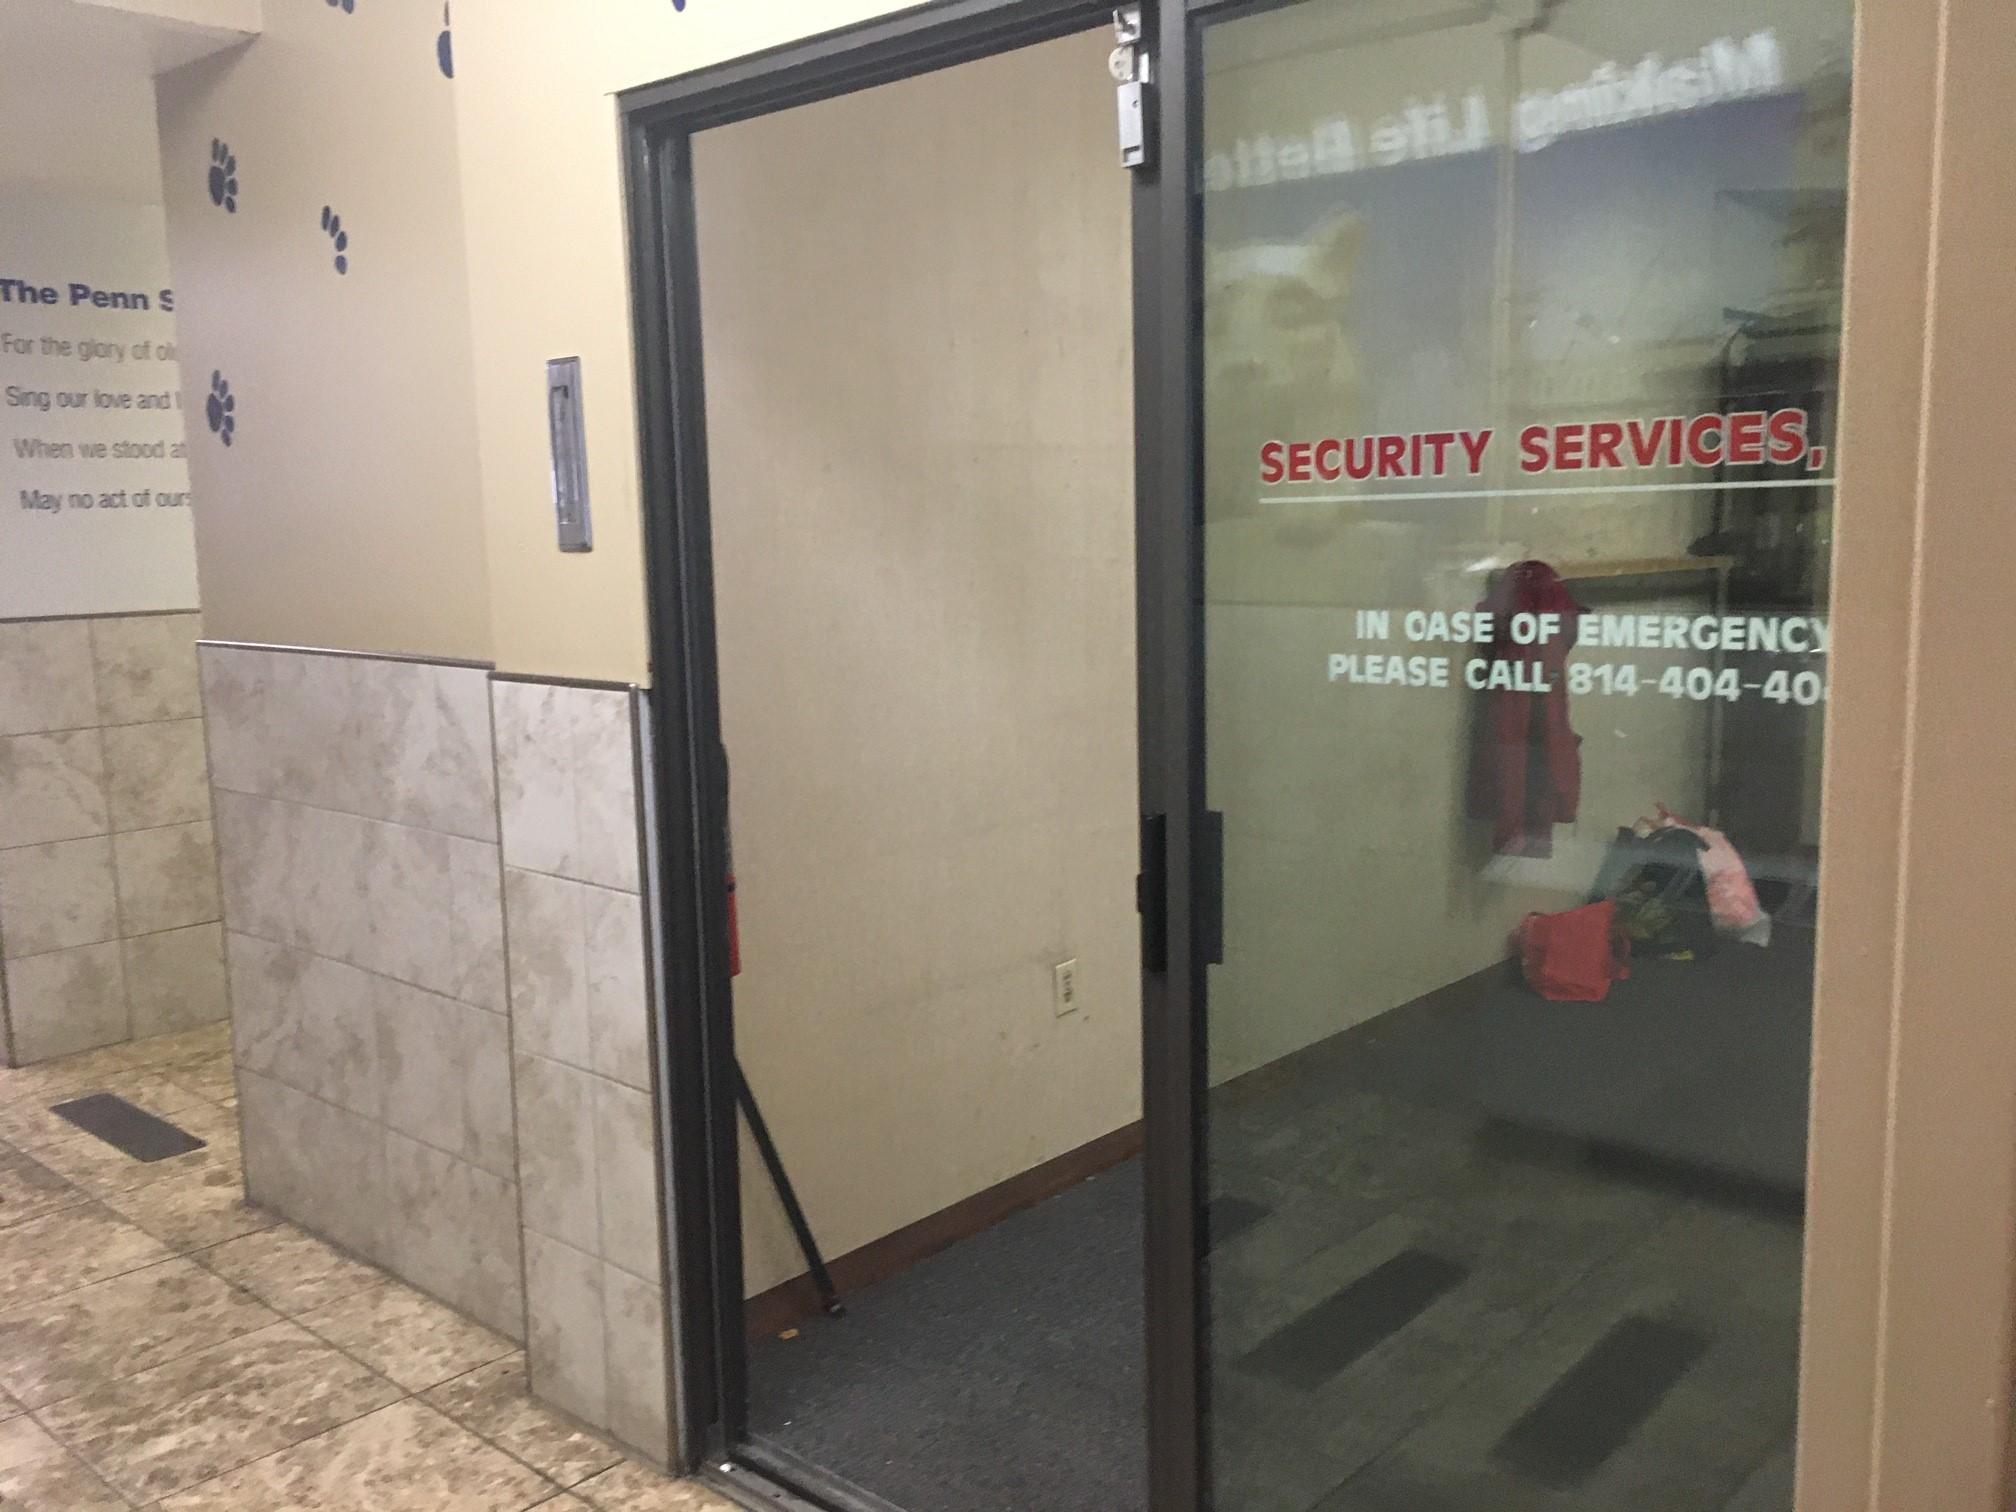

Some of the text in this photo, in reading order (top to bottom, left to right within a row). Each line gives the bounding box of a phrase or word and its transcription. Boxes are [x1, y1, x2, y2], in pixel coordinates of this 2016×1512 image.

[0, 278, 58, 305] The
[69, 283, 149, 310] Penn
[1, 333, 33, 354] For
[40, 336, 71, 356] the
[78, 338, 125, 362] glory
[132, 341, 152, 360] of
[6, 385, 50, 411] Sing
[56, 391, 88, 408] our
[94, 389, 131, 408] love
[137, 391, 170, 409] and
[14, 439, 74, 458] When
[79, 443, 107, 458] we
[112, 440, 165, 458] stood
[1259, 407, 1827, 485] SECURITY SERVICES,
[20, 489, 62, 513] May
[69, 494, 94, 508] no
[99, 490, 128, 508] act
[132, 489, 151, 507] of
[1356, 610, 1829, 653] IN CASE OF EMERGENCY
[1328, 653, 1829, 706] PLEASE CALL 814-404-40
